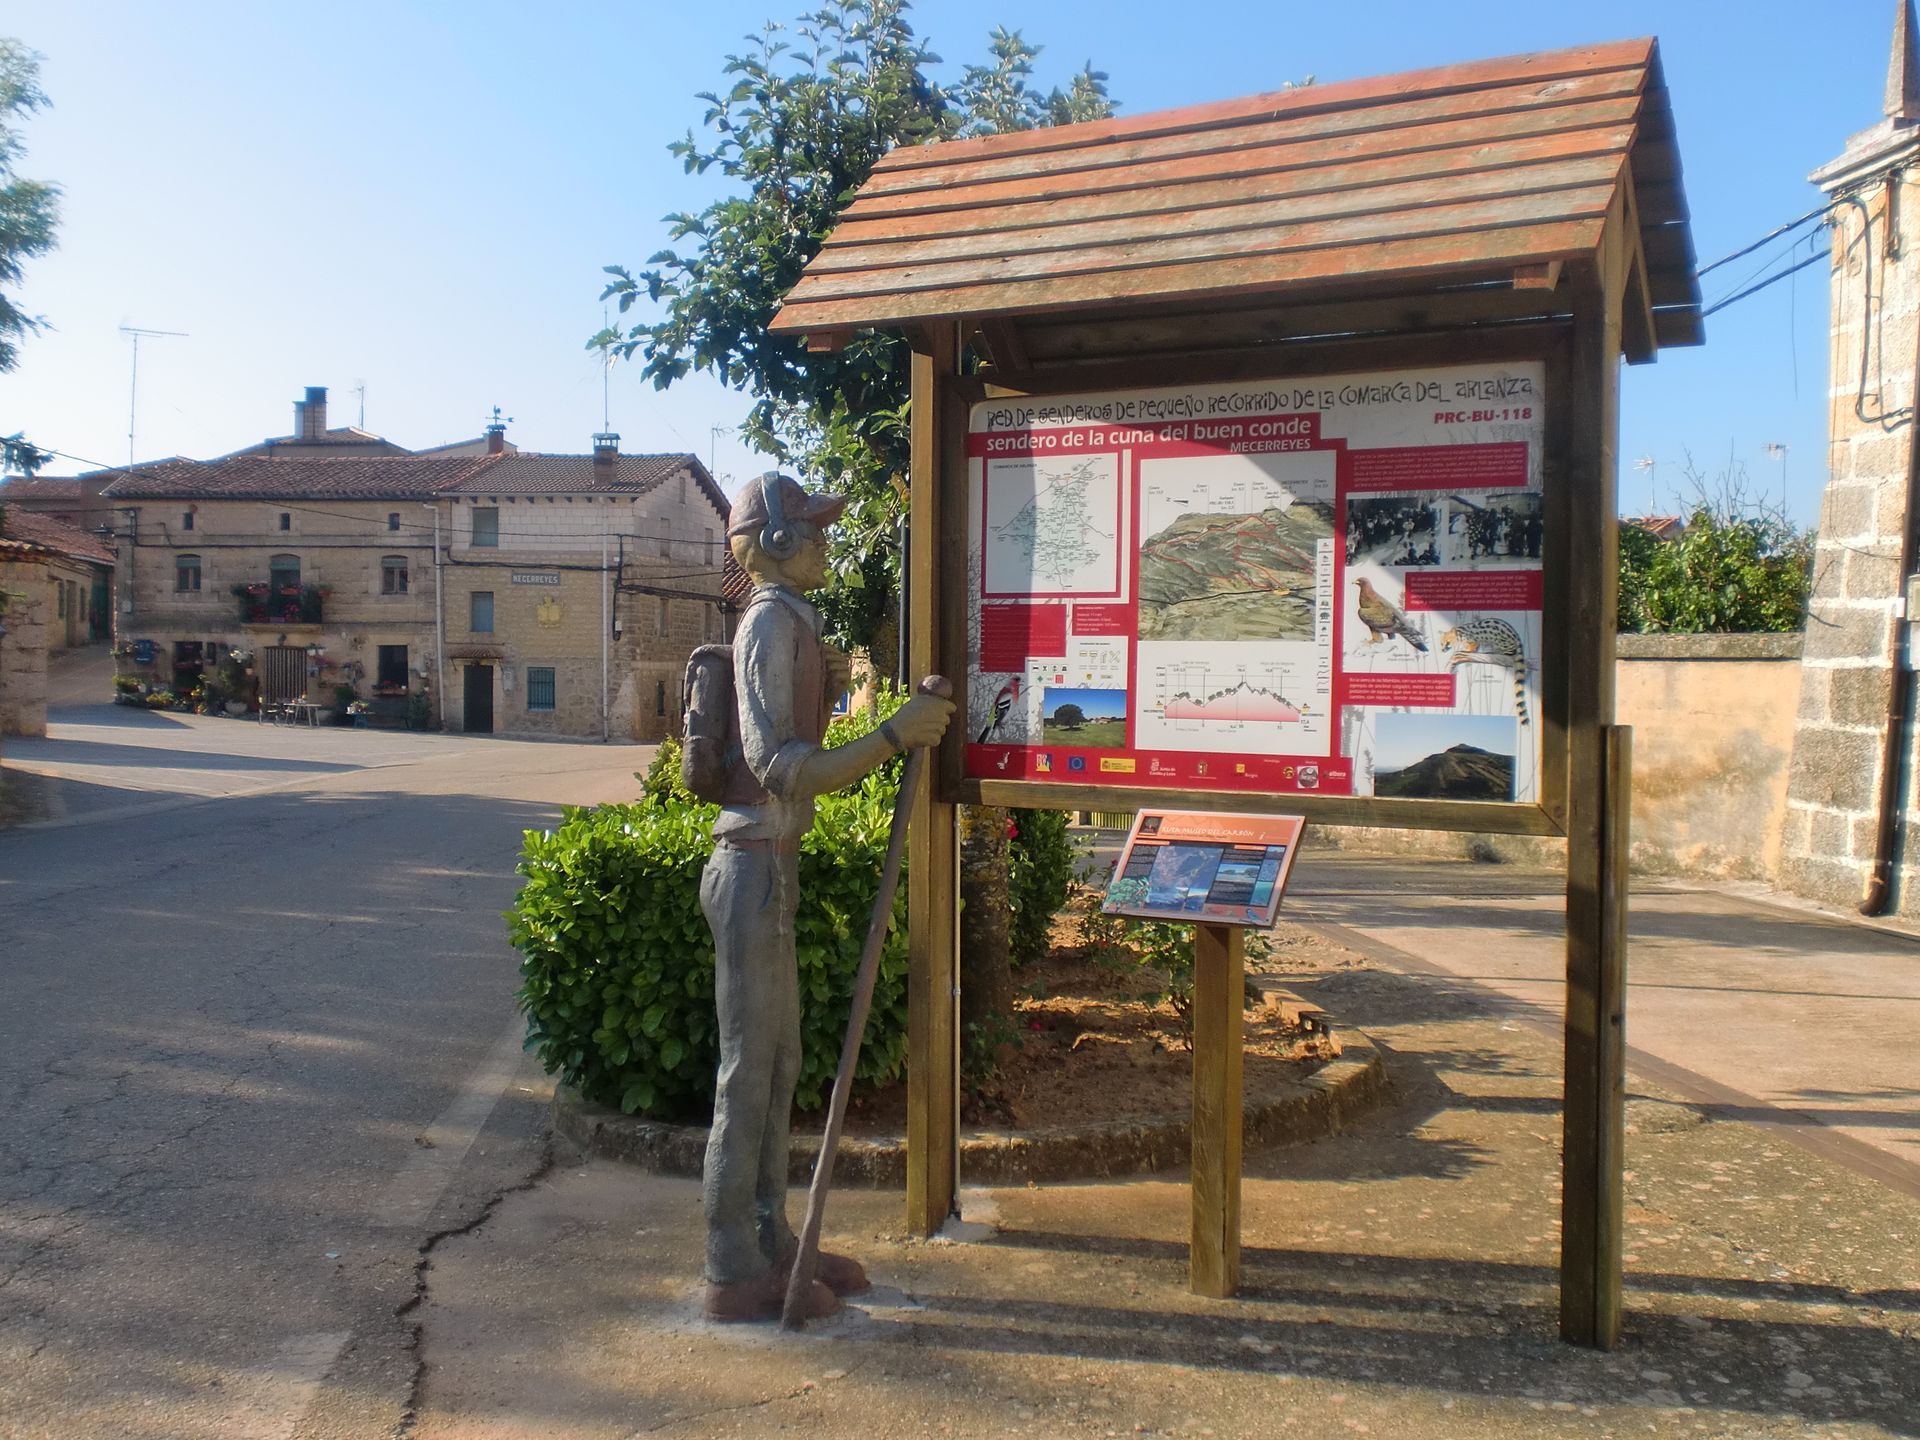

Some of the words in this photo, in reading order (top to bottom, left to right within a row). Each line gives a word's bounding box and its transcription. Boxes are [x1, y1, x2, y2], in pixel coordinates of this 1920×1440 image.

[1434, 408, 1533, 424] PRC-BU-118
[987, 430, 1057, 451] sendero
[1061, 431, 1084, 446] de
[1089, 429, 1104, 446] la
[1109, 430, 1154, 444] cuna
[1159, 424, 1189, 442] del
[1193, 422, 1244, 440] buen
[1250, 417, 1312, 436] conde
[1230, 438, 1311, 453] MECERREYES
